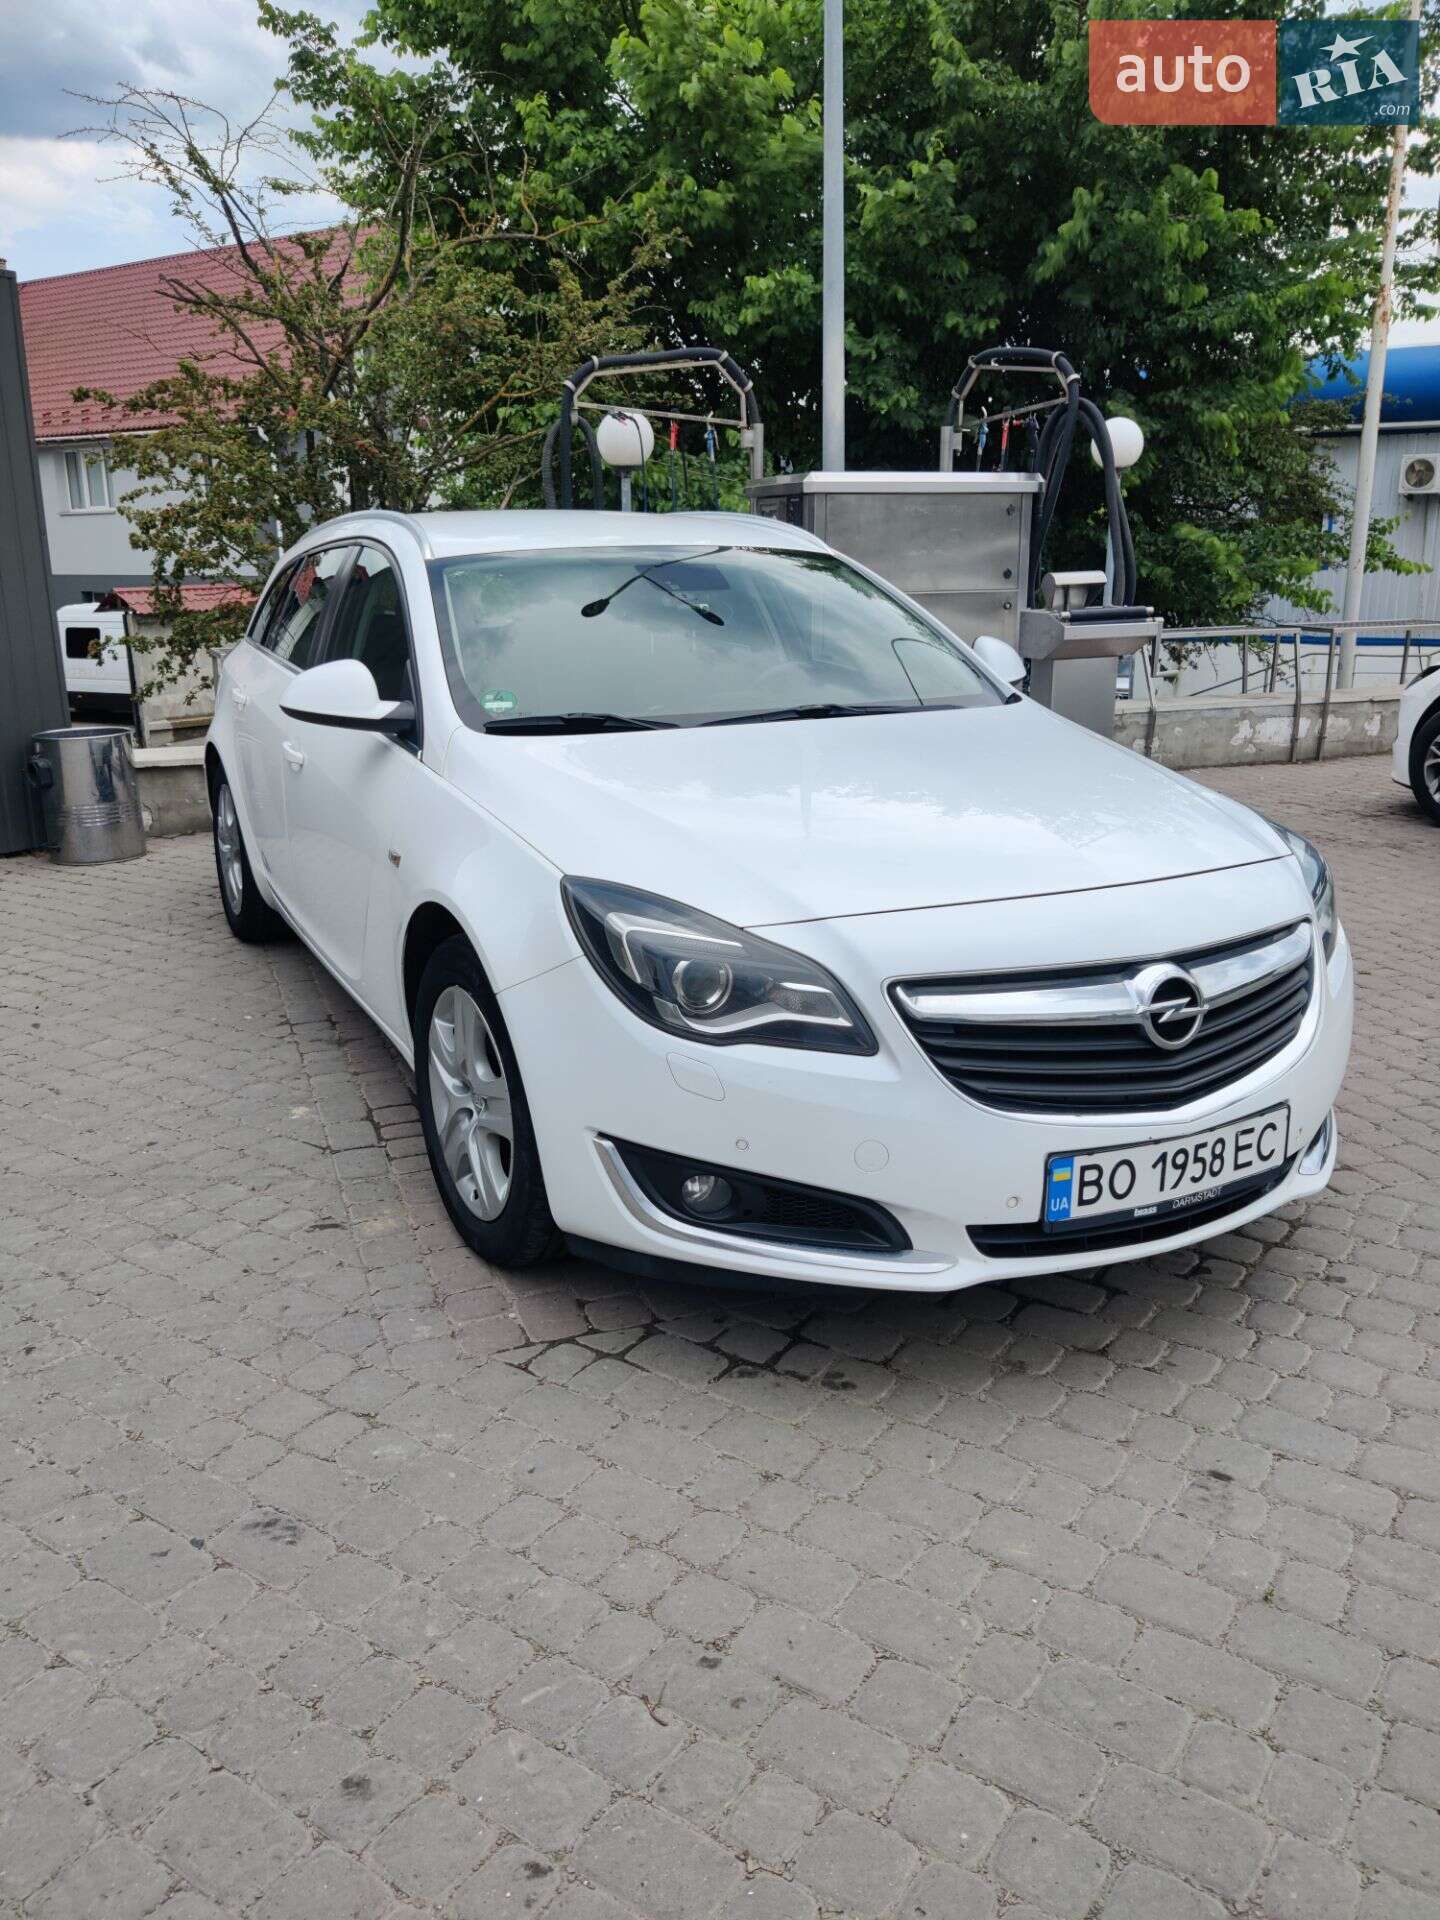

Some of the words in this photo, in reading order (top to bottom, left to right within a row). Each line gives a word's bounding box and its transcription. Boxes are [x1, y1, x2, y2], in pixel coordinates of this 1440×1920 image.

[1077, 1158, 1137, 1207] BO
[1151, 1137, 1226, 1193] 1958
[1233, 1121, 1278, 1172] EC
[1051, 1197, 1069, 1212] UA
[1172, 1186, 1223, 1209] DARMSTADT
